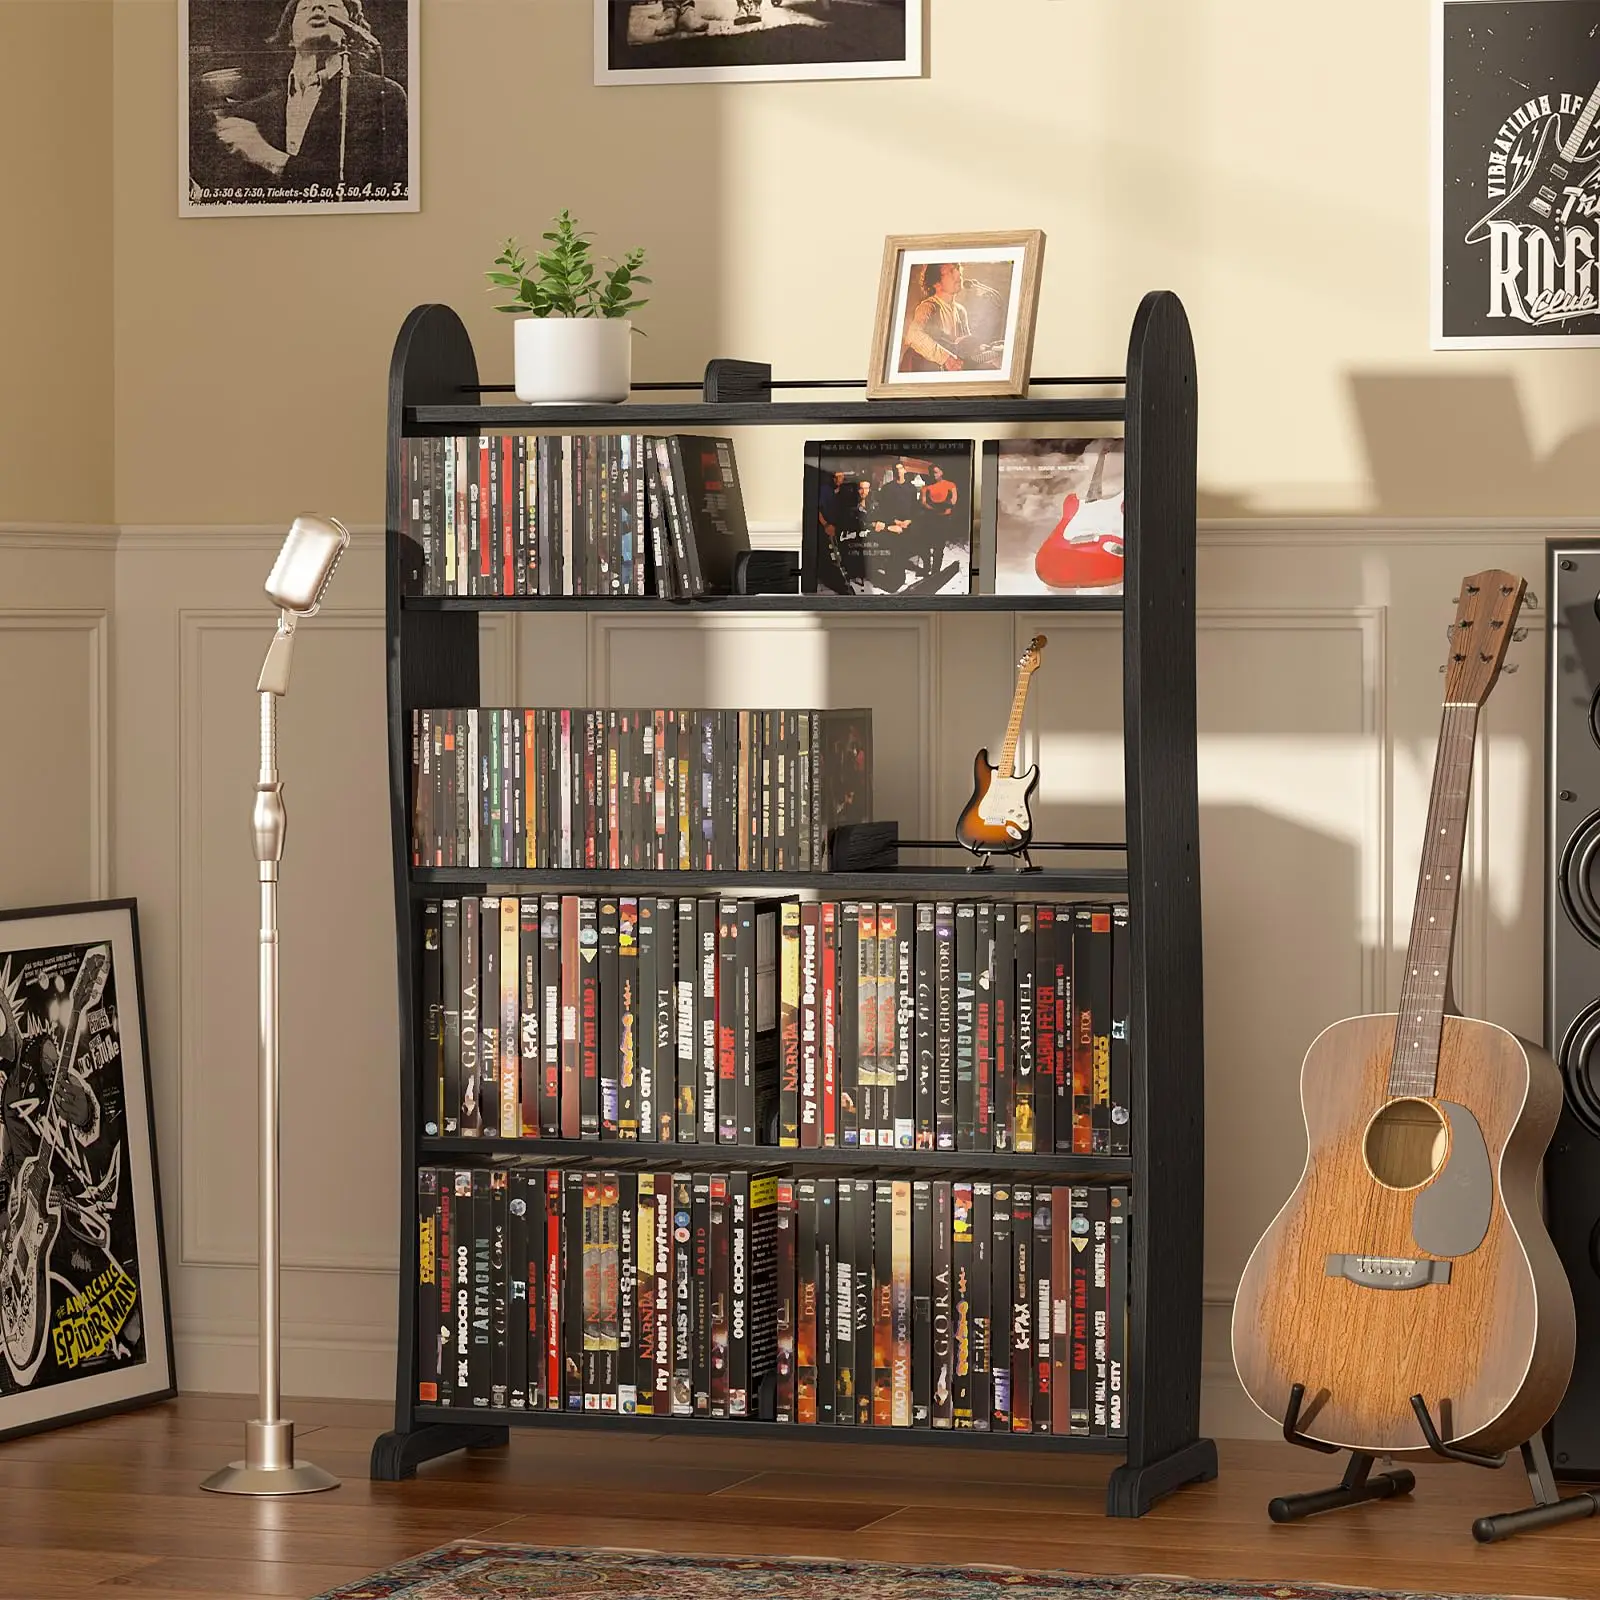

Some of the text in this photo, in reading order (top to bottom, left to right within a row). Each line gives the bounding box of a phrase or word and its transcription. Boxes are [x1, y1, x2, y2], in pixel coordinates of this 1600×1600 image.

[1487, 93, 1584, 199] VIBRATIONS OF
[213, 187, 234, 198] 3:30
[235, 187, 243, 198] &
[244, 187, 265, 200] 7:30,
[1486, 220, 1600, 323] ROC
[462, 978, 477, 1068] G.O.R.A.
[523, 1012, 538, 1058] K-PAX
[658, 990, 669, 1047] LA CASA
[802, 924, 816, 1124] My Mom's New Boyfriend
[940, 940, 951, 1105] A CHINESE GHOST STORY
[1020, 972, 1032, 1076] GABRIEL
[1036, 986, 1054, 1074] CABIN FEVER
[1080, 1010, 1092, 1044] D-TOX
[504, 1071, 515, 1100] MAX
[641, 1067, 651, 1133] MAD CITY
[704, 1088, 714, 1109] HALL
[458, 1245, 468, 1284] 3000
[697, 1228, 705, 1276] RABID
[66, 1263, 118, 1315] ANARCHIC
[655, 1194, 669, 1391] My Mom's New Boyfriend
[805, 1282, 815, 1316] D-TOX
[856, 1271, 867, 1330] LA CASA
[881, 1284, 891, 1317] D-TOX
[934, 1264, 949, 1356] G.O.R.A.
[676, 1301, 687, 1361] WAIST
[734, 1300, 744, 1339] 3000
[1014, 1303, 1030, 1350] K-PAX
[895, 1359, 906, 1388] MAX
[1095, 1380, 1106, 1401] HALL
[1110, 1360, 1121, 1428] MAD CITY
